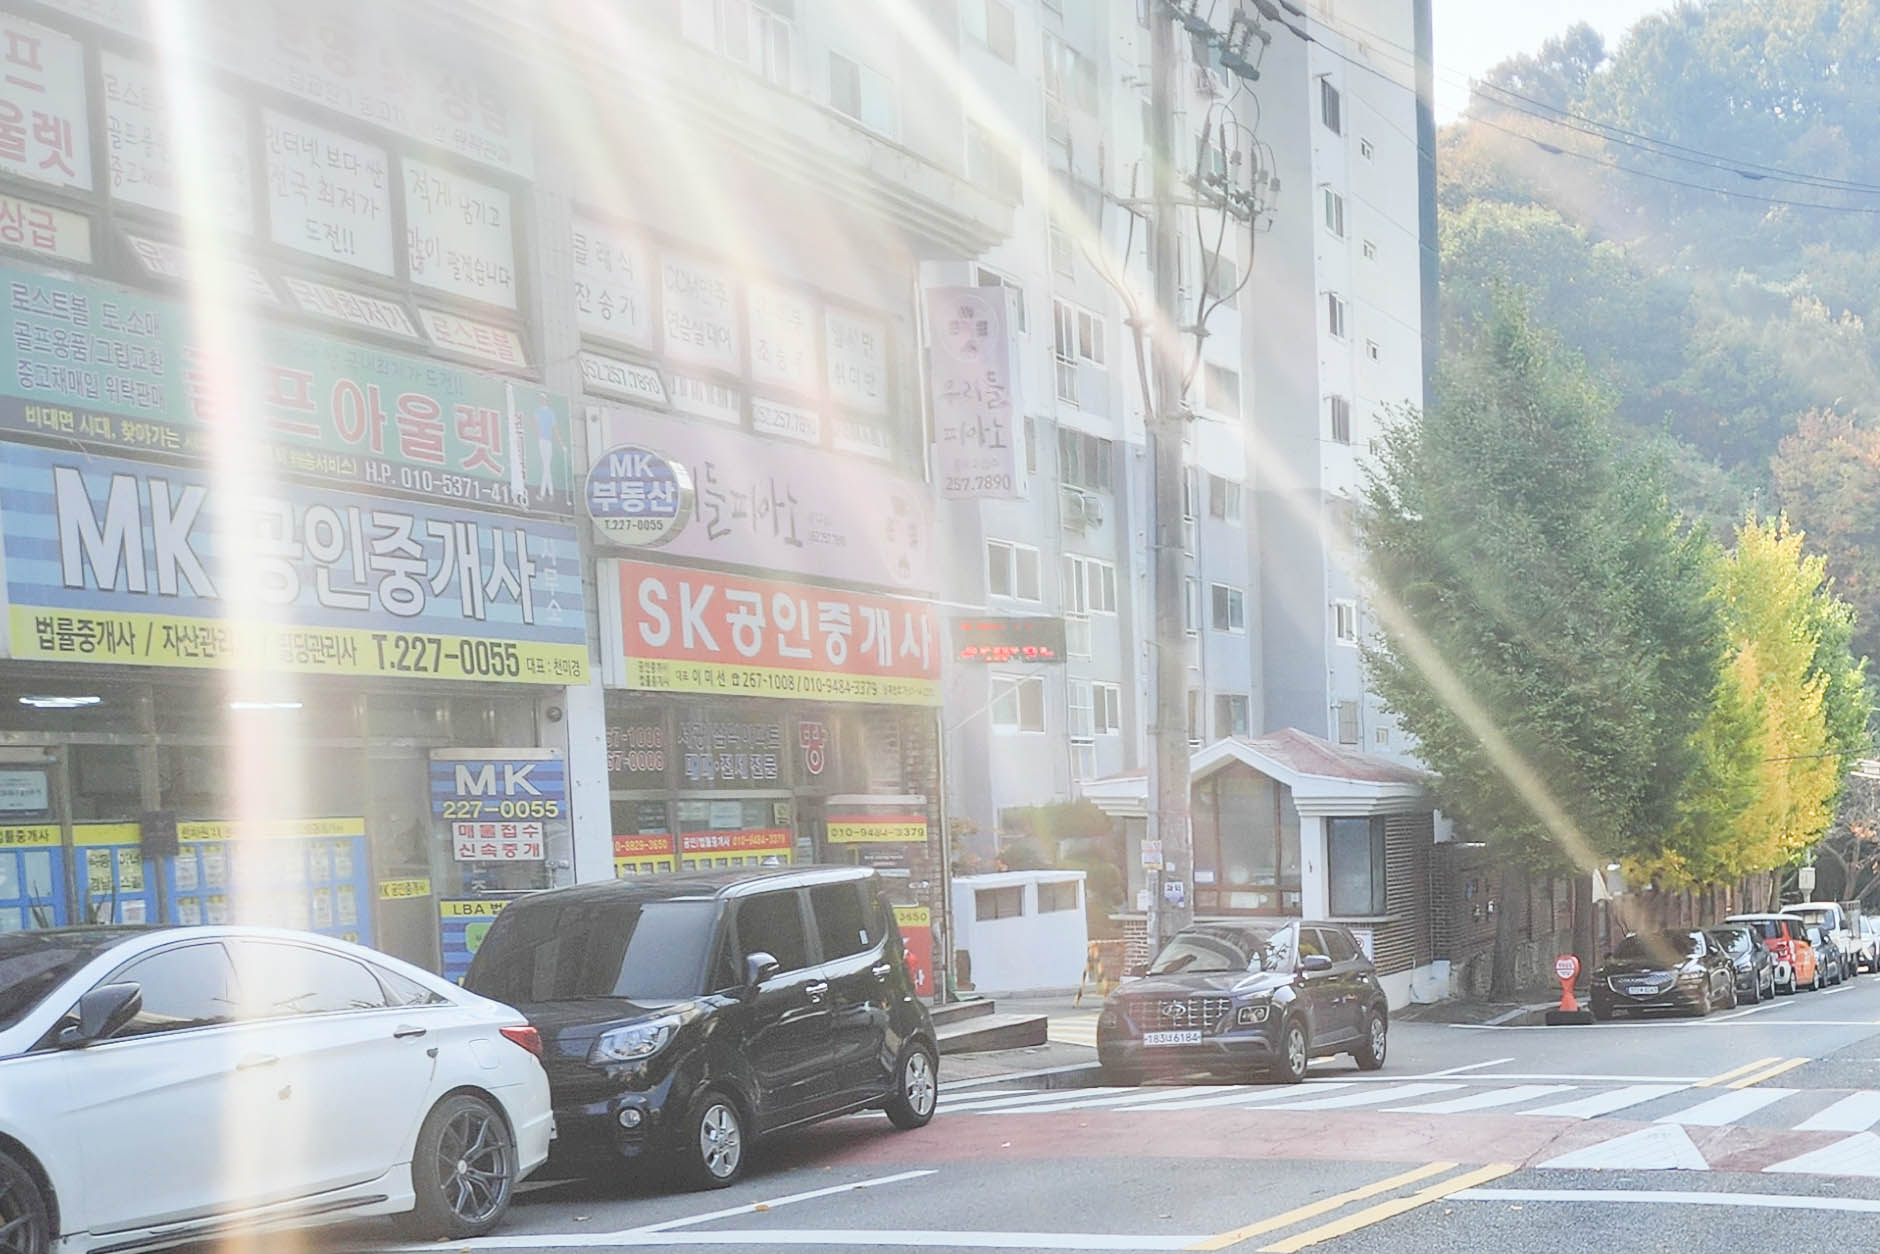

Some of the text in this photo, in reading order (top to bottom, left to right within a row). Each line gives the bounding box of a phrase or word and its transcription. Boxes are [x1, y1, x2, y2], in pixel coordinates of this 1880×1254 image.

[10, 283, 89, 327] 로스트볼
[18, 358, 100, 401] 중고채매입
[24, 404, 76, 435] 비대면
[79, 416, 117, 441] 시대,
[120, 424, 181, 450] 찾아가는
[608, 453, 655, 478] MK
[944, 473, 1012, 491] 257.7890
[591, 480, 676, 513] 부동산
[604, 519, 664, 532] T.227-0055
[53, 465, 536, 625] MK 공인중개사
[35, 616, 136, 656] 법률중개사
[371, 633, 521, 678] T.227-0055
[454, 764, 543, 796] MK
[443, 800, 560, 819] 227-0055
[458, 824, 540, 840] 매물접수
[459, 843, 541, 859] 신속중개
[453, 903, 486, 915] LBA
